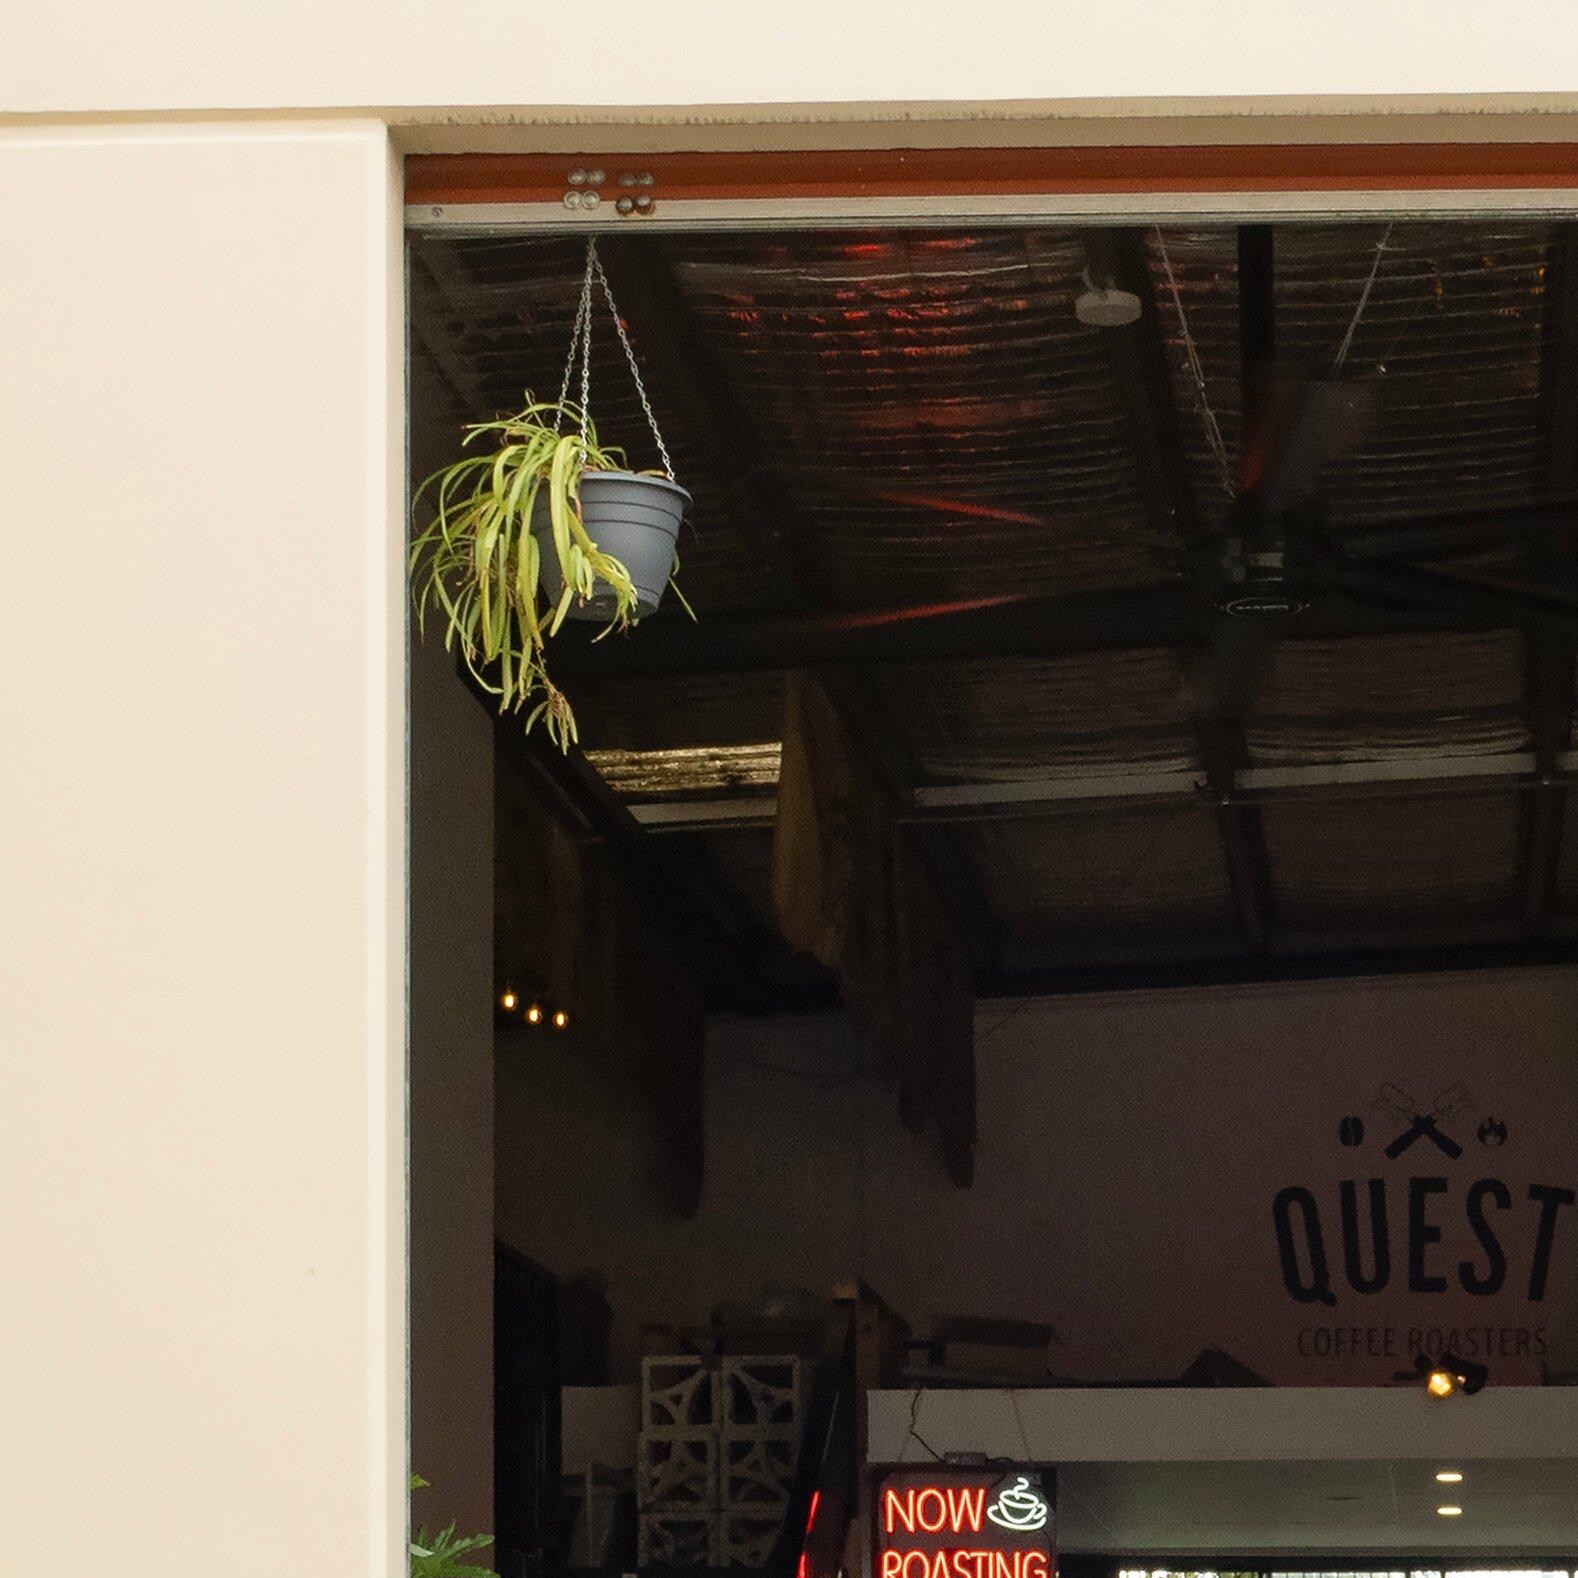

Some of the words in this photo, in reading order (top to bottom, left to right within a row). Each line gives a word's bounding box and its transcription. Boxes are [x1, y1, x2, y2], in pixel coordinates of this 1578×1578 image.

[1272, 1177, 1577, 1306] QUEST
[1298, 1327, 1395, 1357] COFFEE
[1408, 1327, 1548, 1357] ROASTERS
[884, 1487, 987, 1534] NOW
